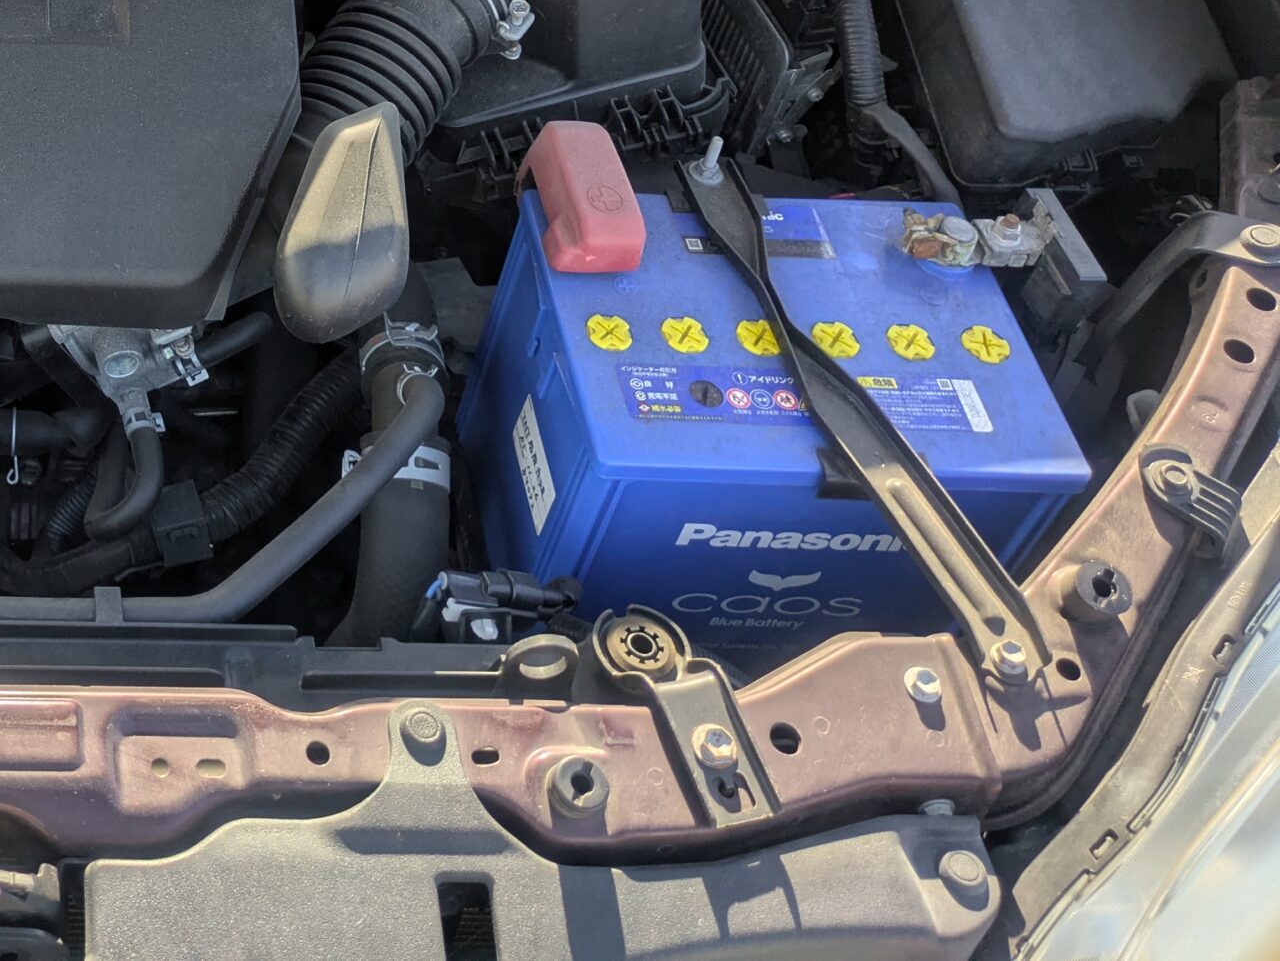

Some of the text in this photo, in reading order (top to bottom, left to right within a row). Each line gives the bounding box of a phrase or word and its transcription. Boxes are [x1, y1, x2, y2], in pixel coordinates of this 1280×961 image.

[671, 593, 863, 617] caos
[709, 616, 804, 630] Blue Battery
